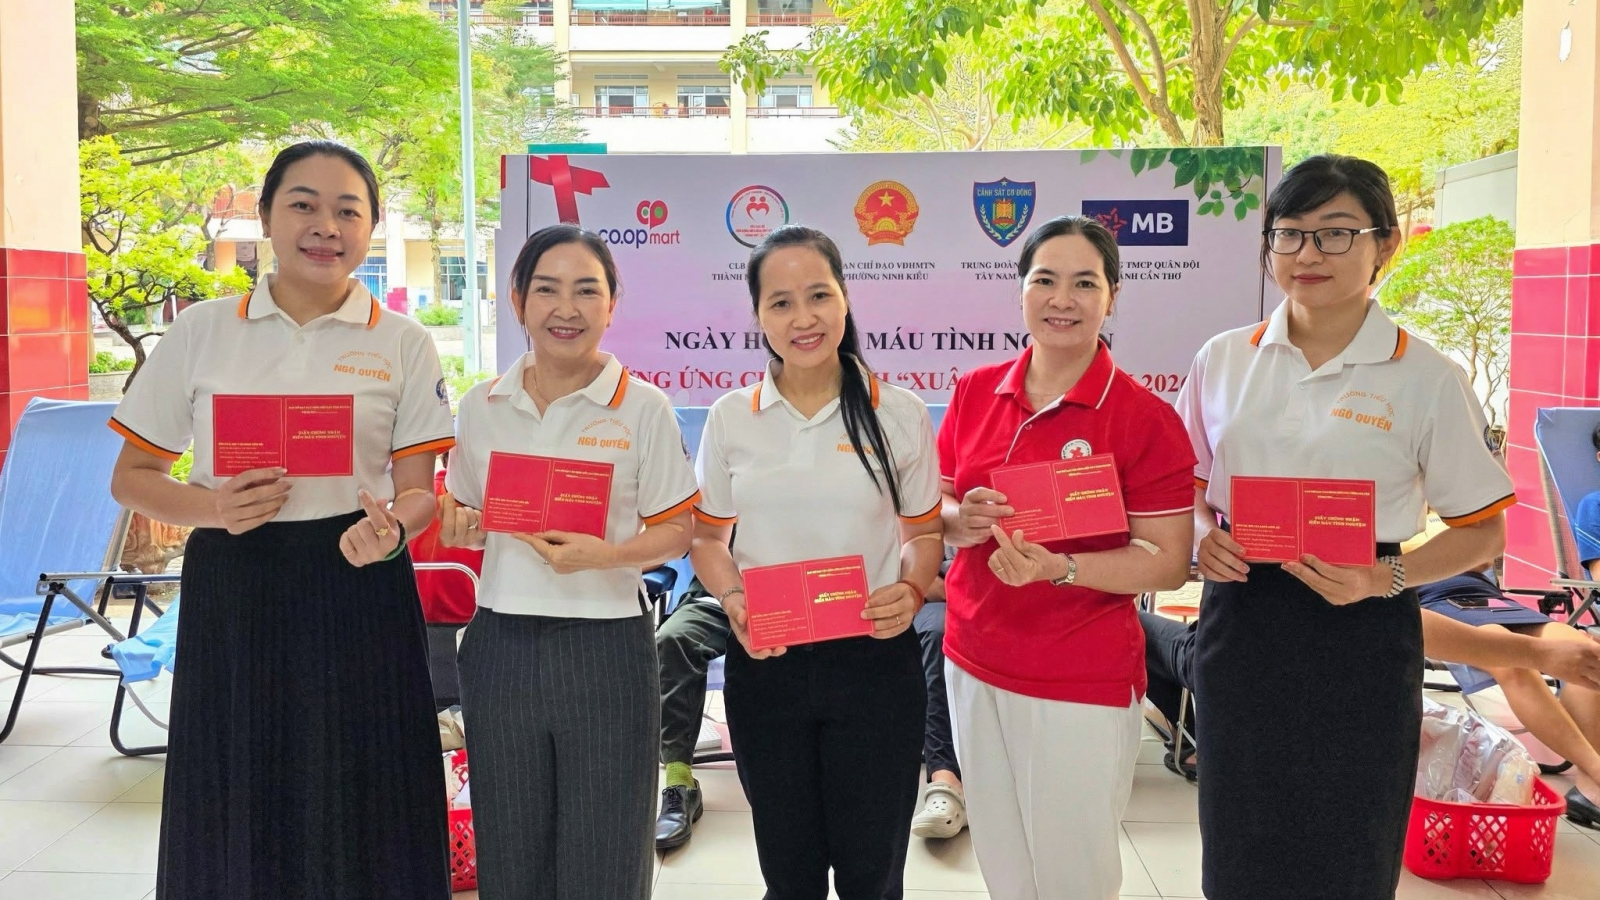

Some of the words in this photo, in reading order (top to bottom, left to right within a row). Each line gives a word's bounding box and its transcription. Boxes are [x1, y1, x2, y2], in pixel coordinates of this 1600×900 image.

[1131, 212, 1174, 234] MB
[728, 262, 746, 270] CLB
[875, 261, 895, 271] ĐẠO
[896, 261, 936, 270] VĐHMTN
[961, 261, 992, 269] TRUNG
[1126, 261, 1153, 269] TMCP
[1154, 260, 1181, 270] QUÂN
[1183, 260, 1200, 270] ĐỘI
[711, 271, 743, 281] THÀNH
[881, 272, 904, 281] NINH
[975, 271, 993, 280] TÂY
[1161, 272, 1182, 280] THƠ
[665, 326, 736, 350] NGÀY
[866, 326, 925, 351] MÁU
[931, 326, 996, 351] TÌNH
[333, 363, 356, 374] NGÔ
[678, 365, 734, 390] ỨNG
[897, 366, 962, 391] “XUÂ
[1141, 373, 1188, 393] 202
[1330, 407, 1353, 420] NGÔ
[577, 436, 597, 447] NGÔ
